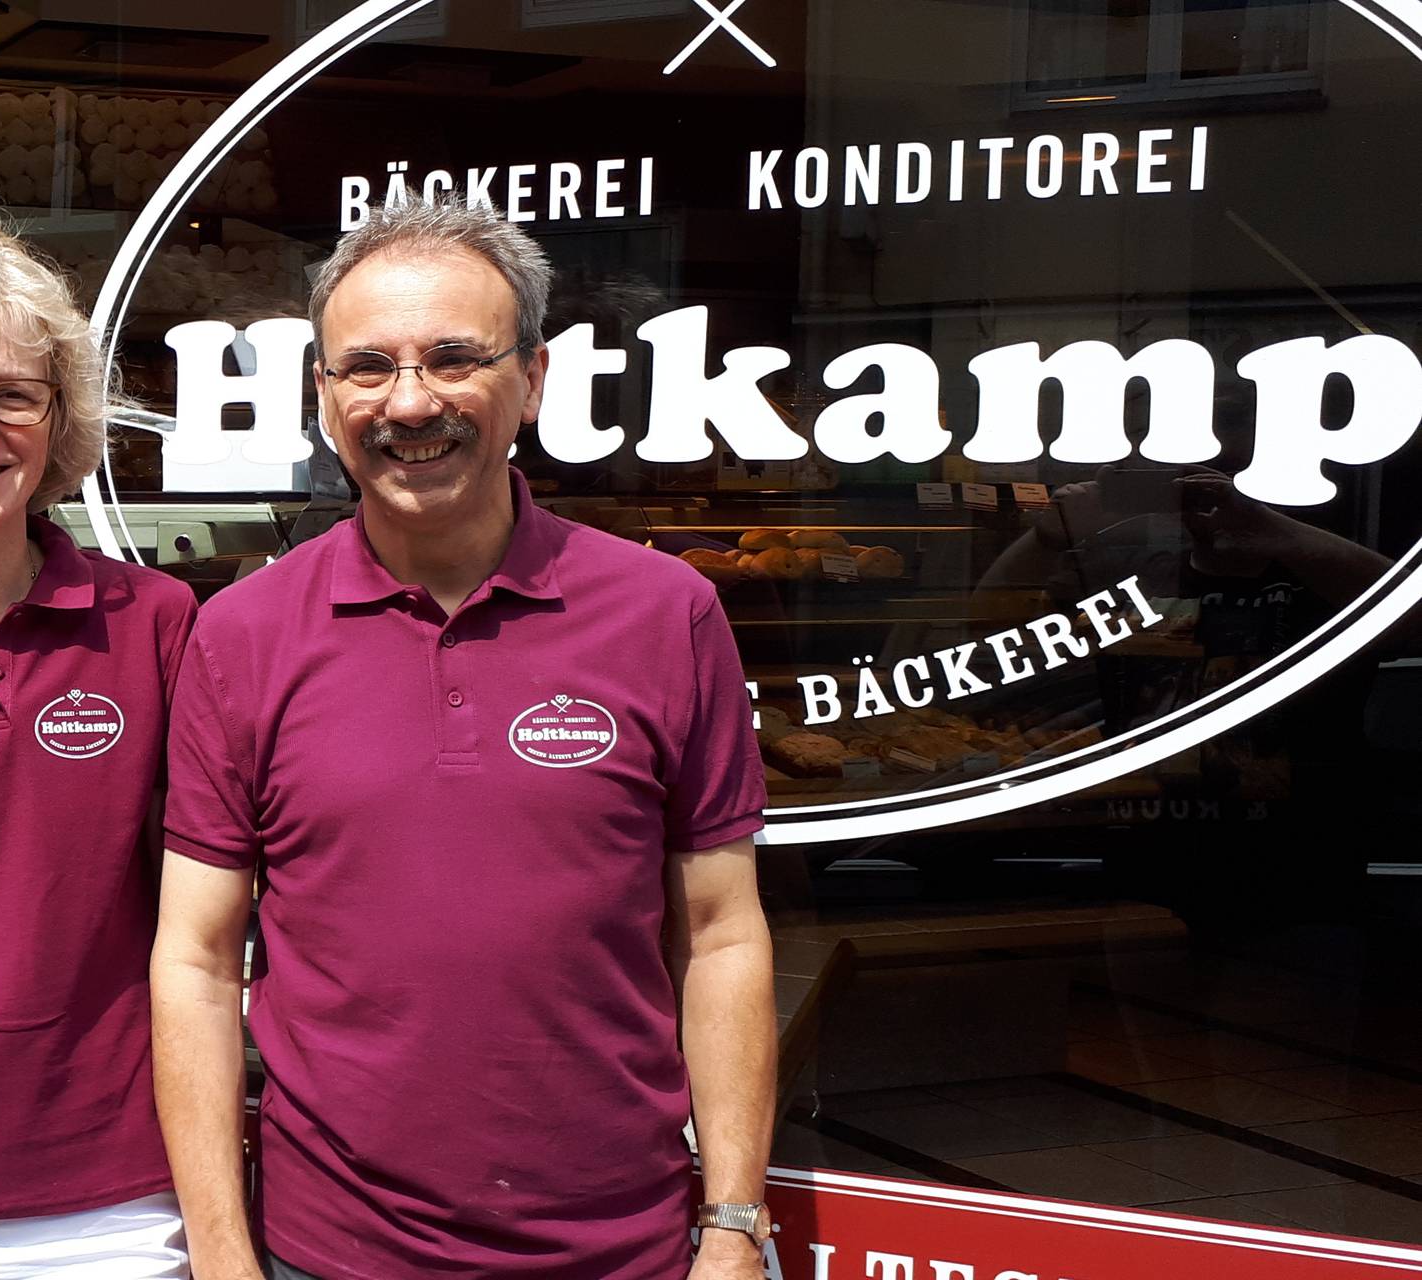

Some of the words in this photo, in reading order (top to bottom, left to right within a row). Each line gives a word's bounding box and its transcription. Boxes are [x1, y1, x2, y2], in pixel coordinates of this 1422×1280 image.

[341, 157, 653, 232] BÄCKEREI
[749, 126, 1208, 210] KONDITOREI
[164, 305, 1422, 506] Htkamp
[797, 575, 1164, 725] BÄCKEREI
[41, 721, 118, 735] Holtkamp
[517, 727, 611, 743] Holtkamp
